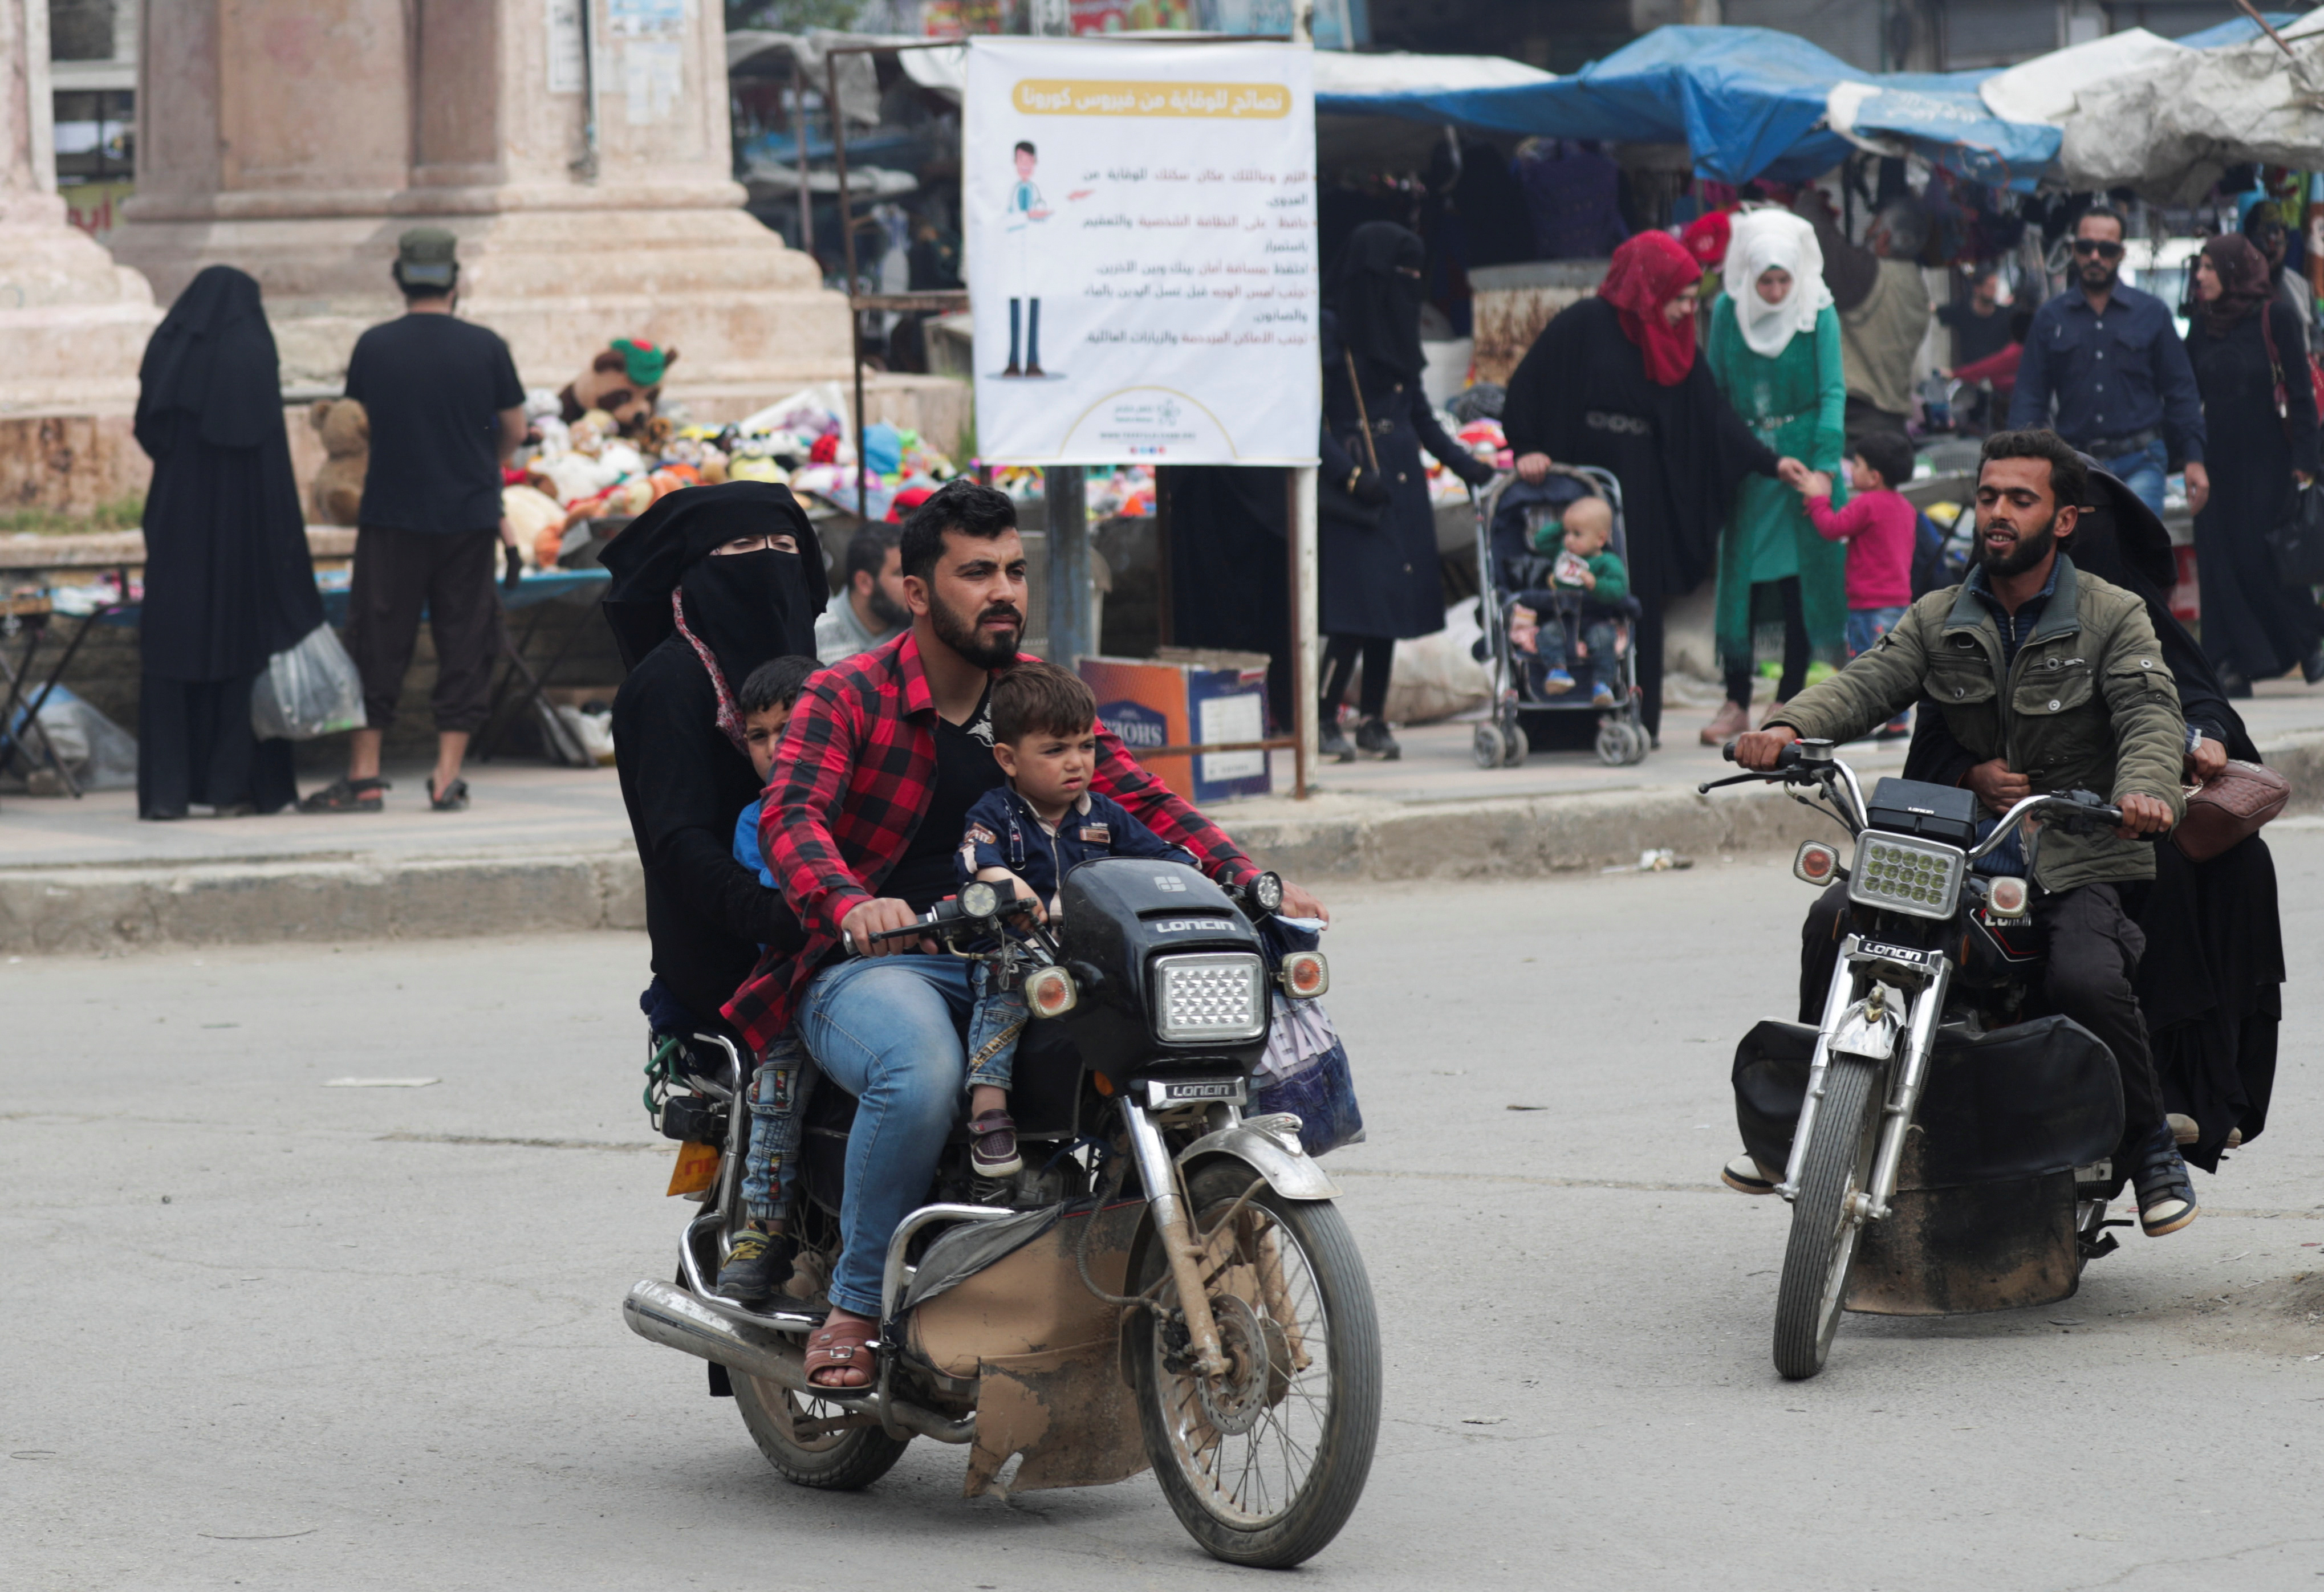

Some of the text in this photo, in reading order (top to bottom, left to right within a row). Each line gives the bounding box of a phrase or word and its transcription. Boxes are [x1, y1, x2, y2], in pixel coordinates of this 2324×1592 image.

[1021, 85, 1283, 116] نصائح للوقاية من فيروس كورونا
[1108, 168, 1148, 182] للوقاية
[1196, 169, 1225, 184] مكان
[1083, 213, 1133, 229] والتعقيم
[1138, 213, 1191, 229] الشخصية
[1197, 214, 1238, 228] النظافة
[1244, 215, 1267, 232] على
[1141, 263, 1167, 276] وبين
[1226, 260, 1270, 276] بمسافة
[1118, 283, 1151, 298] اليدين
[1212, 284, 1242, 299] الوجه
[1156, 921, 1236, 933] LONCIN
[1864, 943, 1922, 962] LONCIN
[1173, 1085, 1229, 1097] LONCIN
